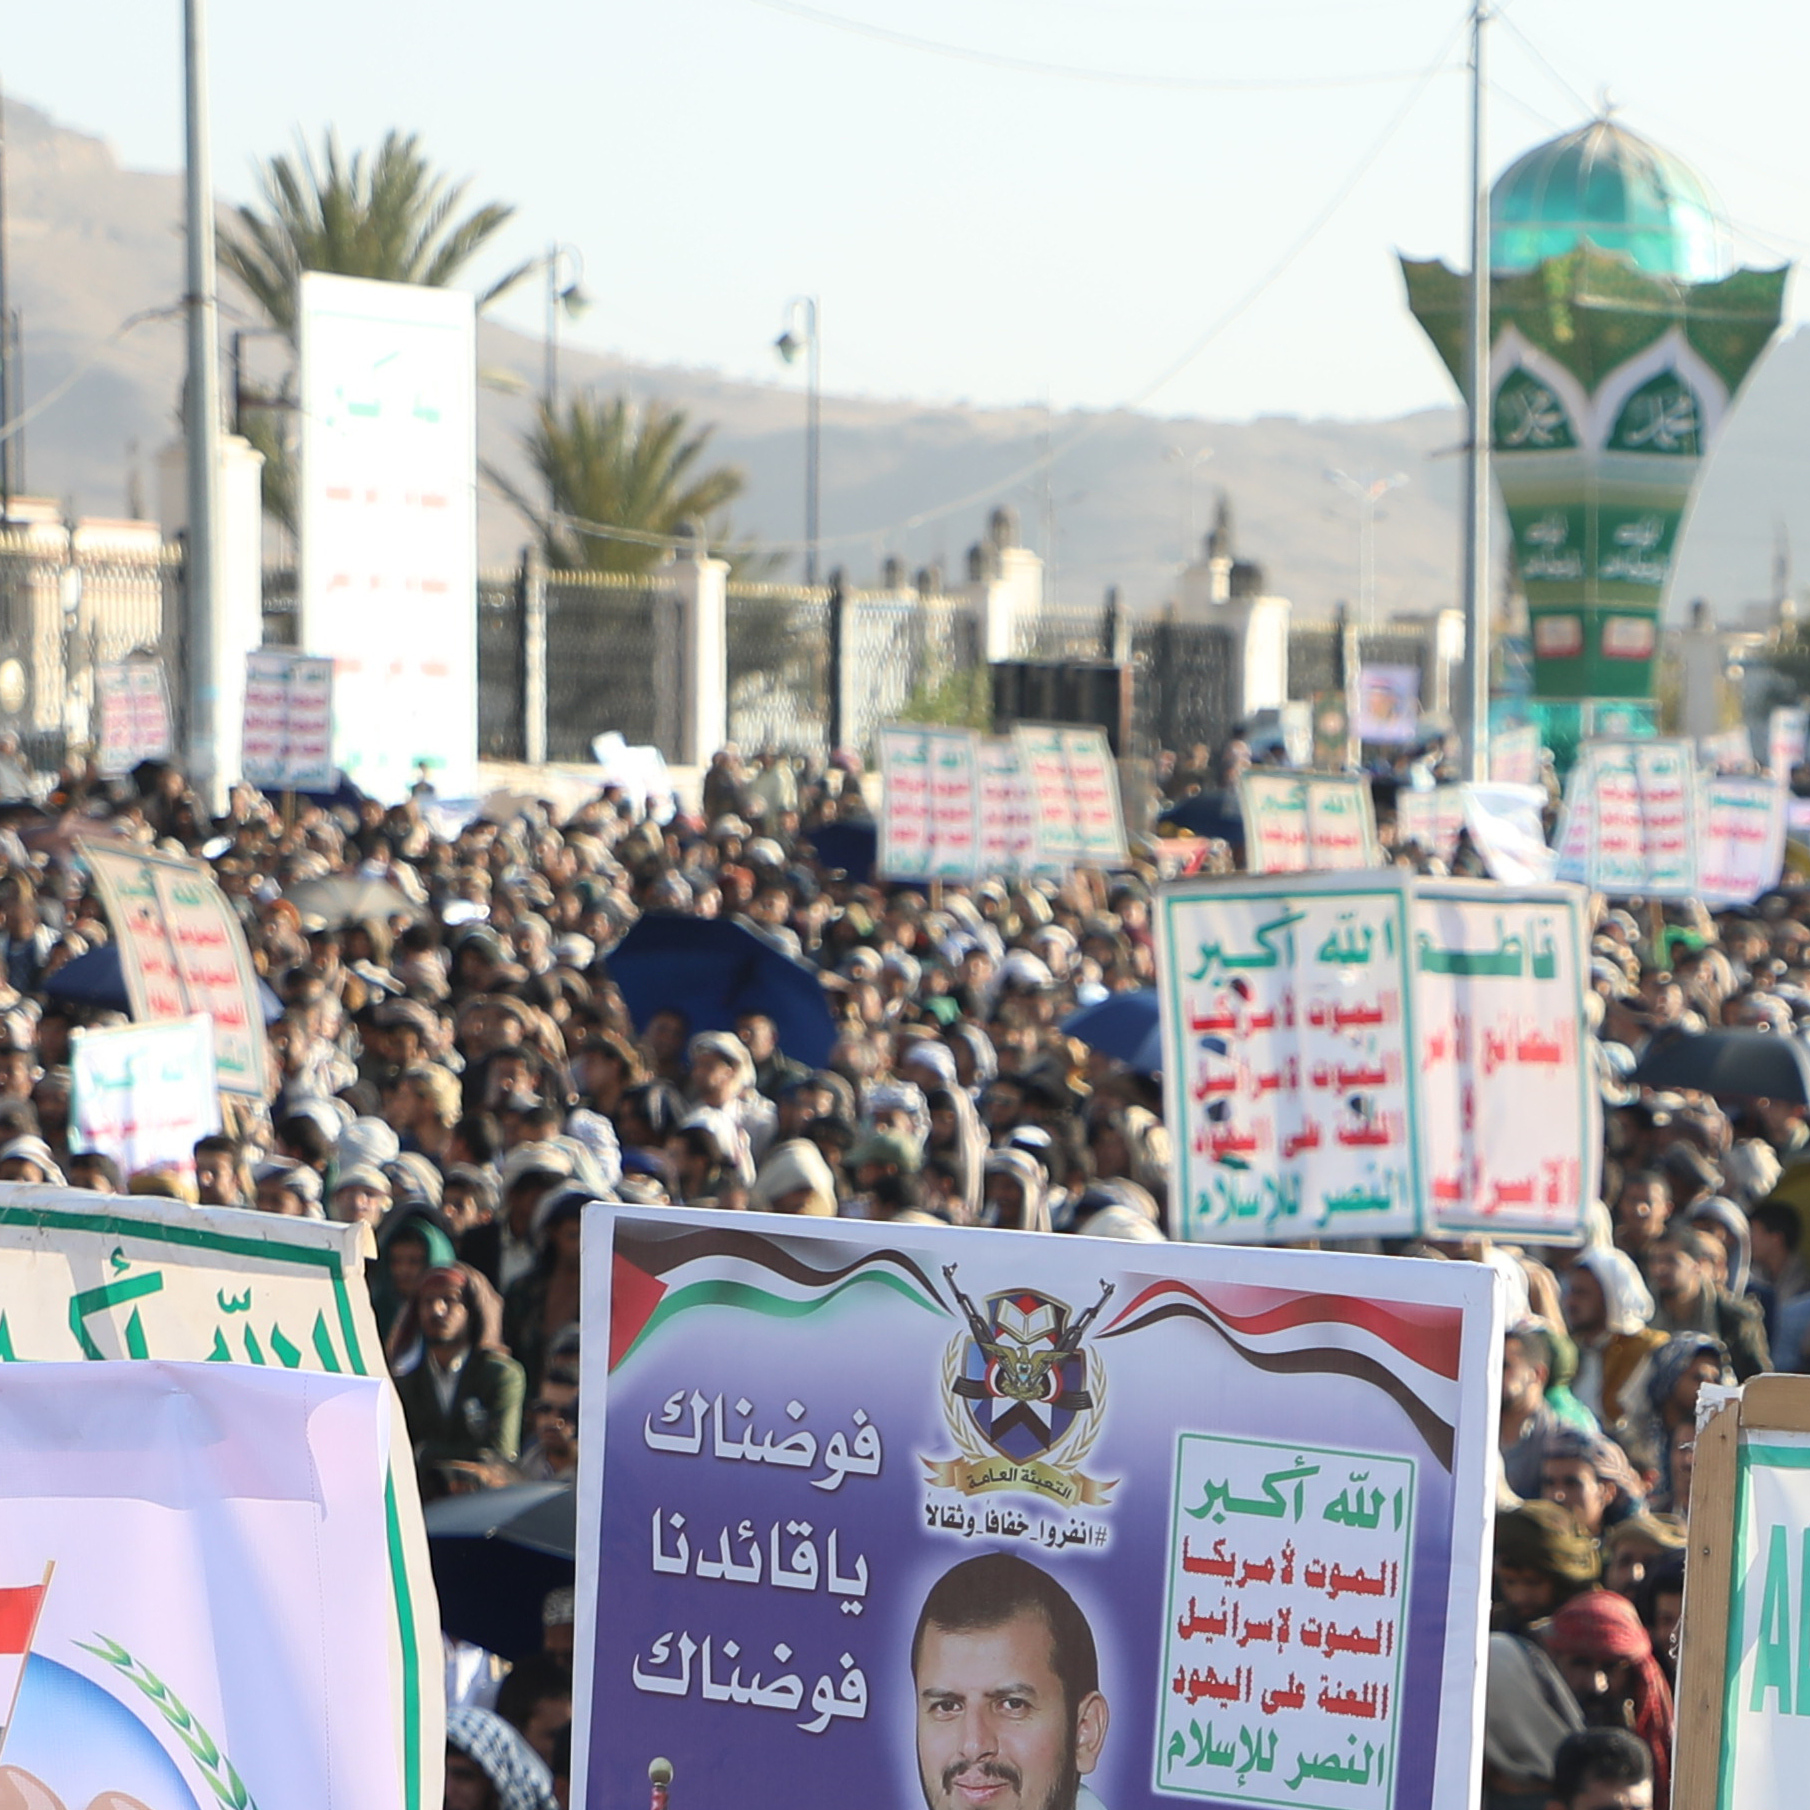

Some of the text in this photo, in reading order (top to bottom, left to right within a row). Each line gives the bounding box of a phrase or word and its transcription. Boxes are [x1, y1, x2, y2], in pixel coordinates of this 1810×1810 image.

[644, 1388, 883, 1491] فوضناك
[1183, 1456, 1403, 1532] الله أكبر
[1182, 1535, 1399, 1600] الموت لأمريكا
[1177, 1596, 1393, 1659] الموت لإسرائيل
[632, 1630, 868, 1734] فوضناك
[1172, 1664, 1389, 1722] اللعنة على اليهود
[1166, 1718, 1386, 1790] النصر للإسلام
